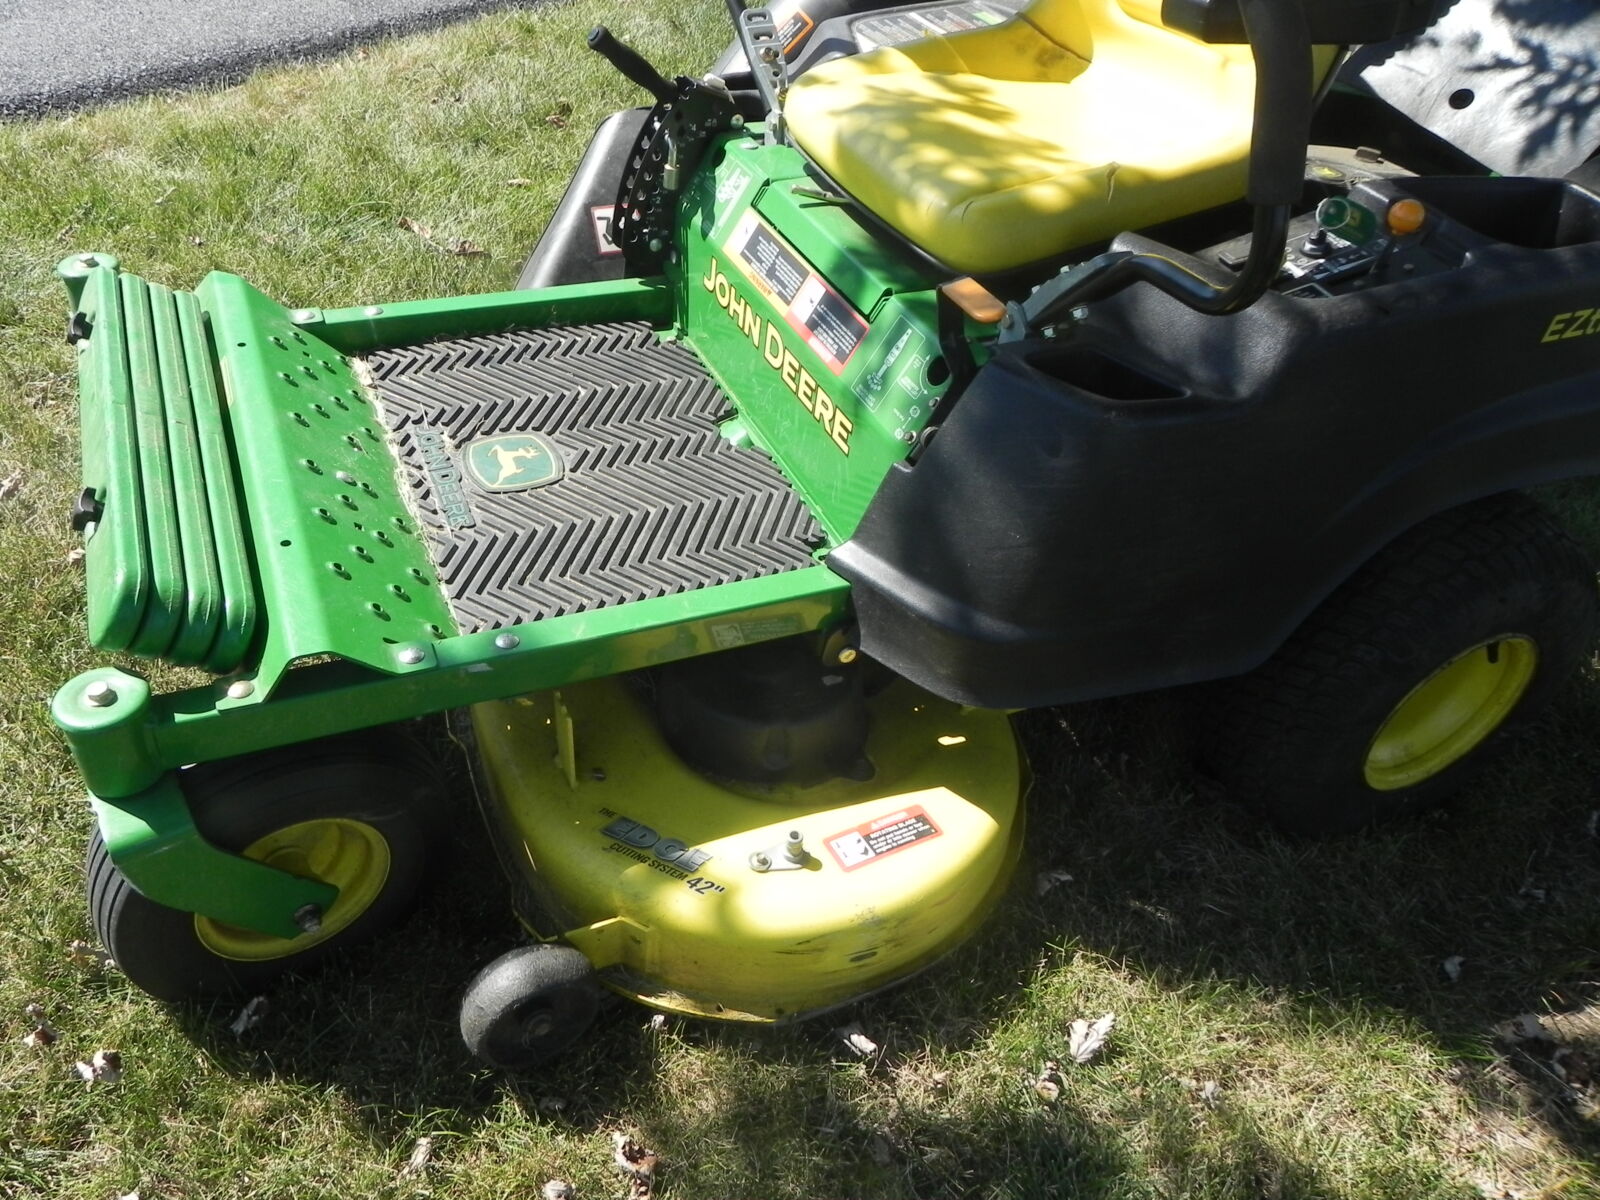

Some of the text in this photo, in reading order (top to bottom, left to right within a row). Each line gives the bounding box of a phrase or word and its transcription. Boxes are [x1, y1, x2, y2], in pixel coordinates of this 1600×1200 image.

[1541, 308, 1600, 343] EZt
[703, 257, 762, 348] JOHN
[764, 319, 854, 457] DEERE
[414, 426, 453, 470] JOHN
[599, 808, 617, 818] THE
[601, 816, 713, 873] EDGE
[610, 842, 726, 894] CUTTING SYSTEM 42"
